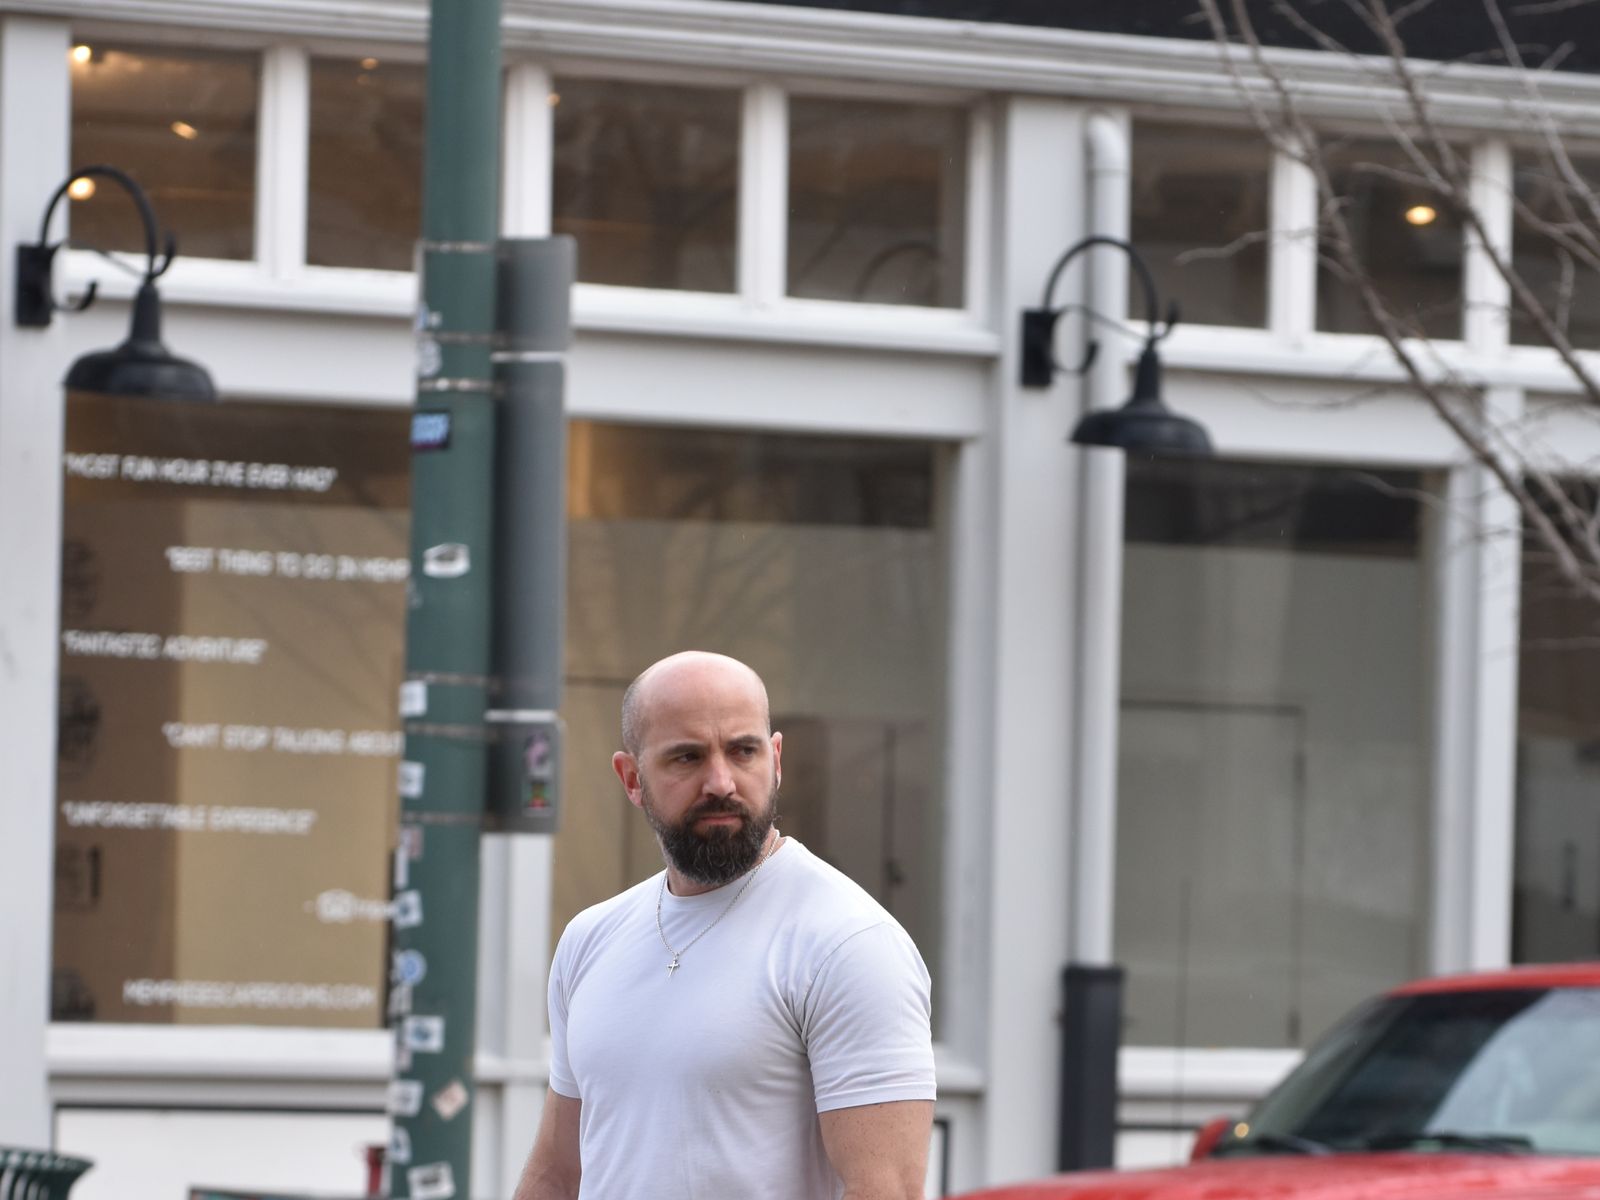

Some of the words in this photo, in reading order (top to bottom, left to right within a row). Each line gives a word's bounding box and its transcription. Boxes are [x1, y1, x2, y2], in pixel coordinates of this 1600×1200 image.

[121, 455, 157, 481] FUN
[159, 457, 210, 484] HOUR
[247, 462, 290, 489] EVER
[277, 551, 301, 577] TO
[302, 553, 334, 579] DO
[222, 724, 271, 750] STOP
[273, 727, 346, 754] TALKING
